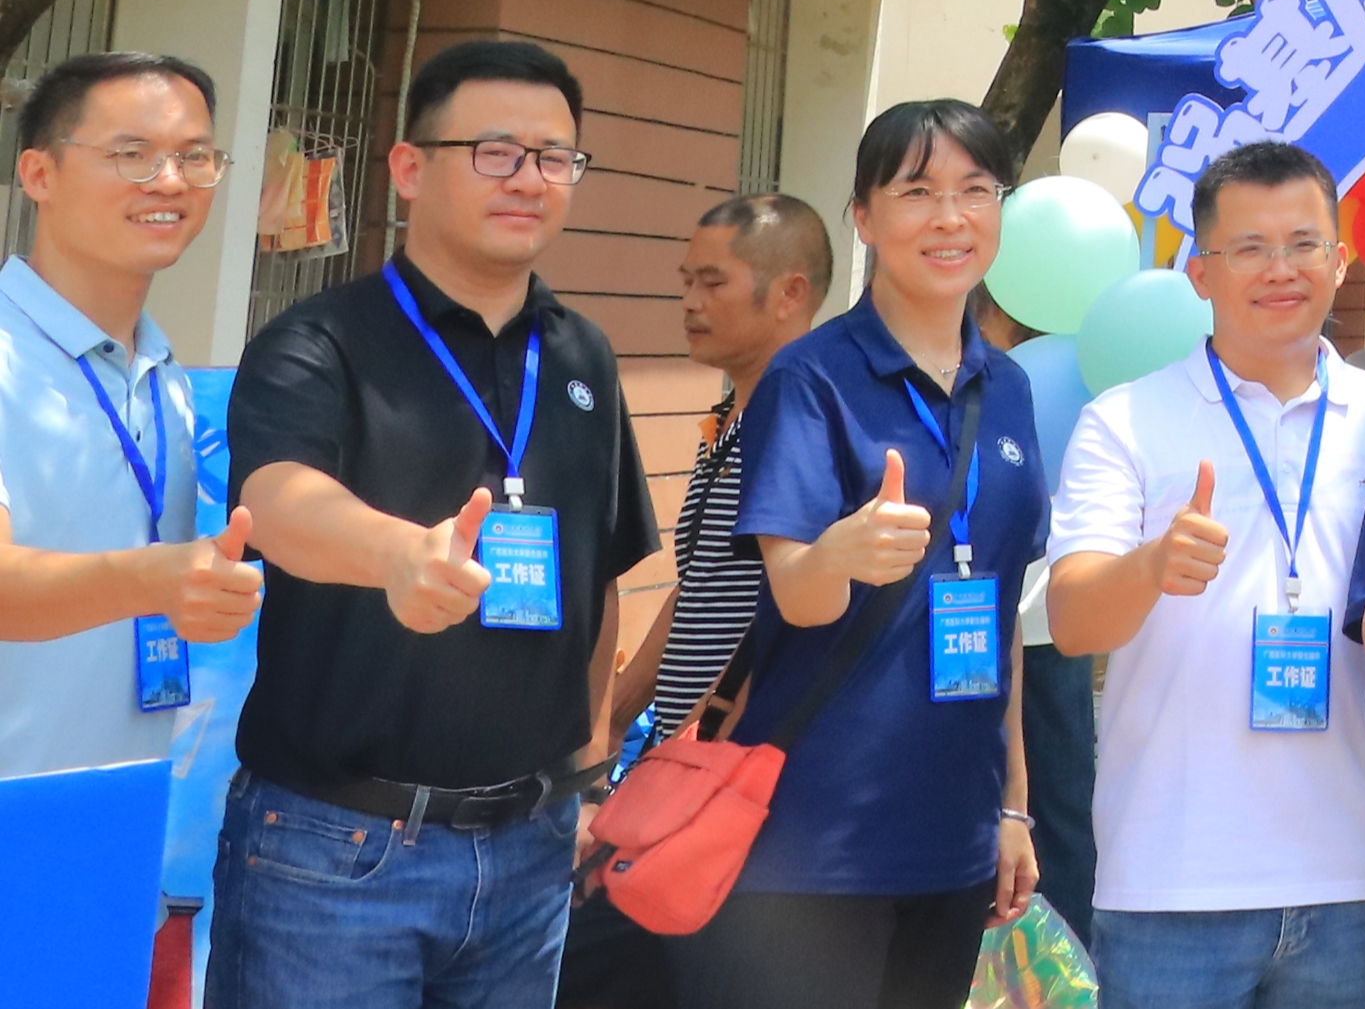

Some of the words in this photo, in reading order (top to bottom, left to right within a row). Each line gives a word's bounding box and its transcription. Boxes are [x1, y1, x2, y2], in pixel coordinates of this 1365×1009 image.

[495, 563, 546, 586] 工作证
[944, 631, 987, 654] 工作证
[1266, 665, 1316, 688] 工作证
